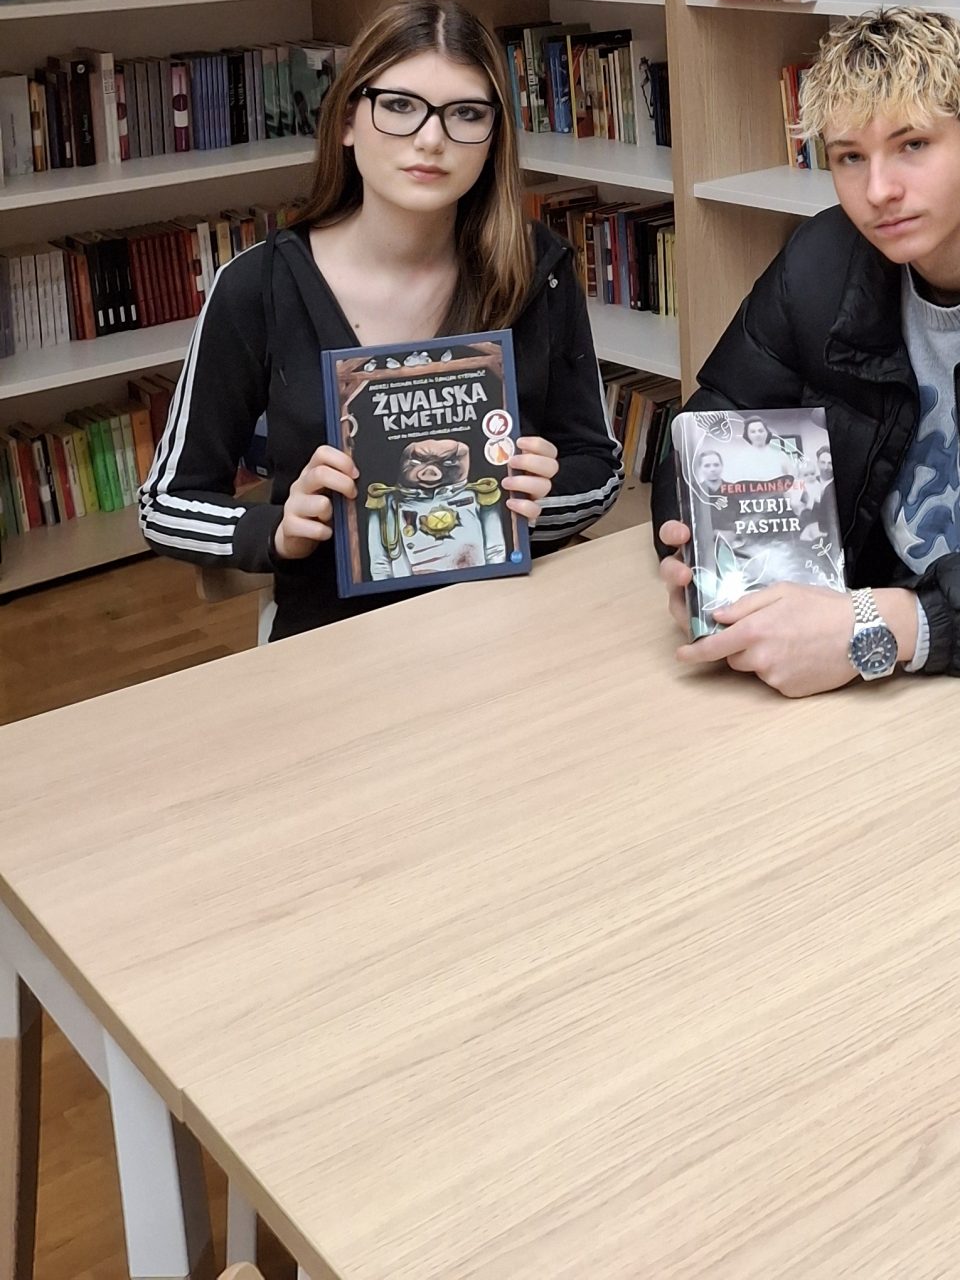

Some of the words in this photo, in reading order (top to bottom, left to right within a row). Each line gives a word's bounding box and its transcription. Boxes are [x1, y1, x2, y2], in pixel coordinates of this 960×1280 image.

[372, 382, 488, 416] ŽIVALSKA
[382, 405, 478, 431] KMETIJA
[720, 483, 746, 494] FERI
[749, 479, 807, 493] LAINŠČEK
[739, 497, 793, 515] KURJI
[734, 518, 801, 535] PASTIR
